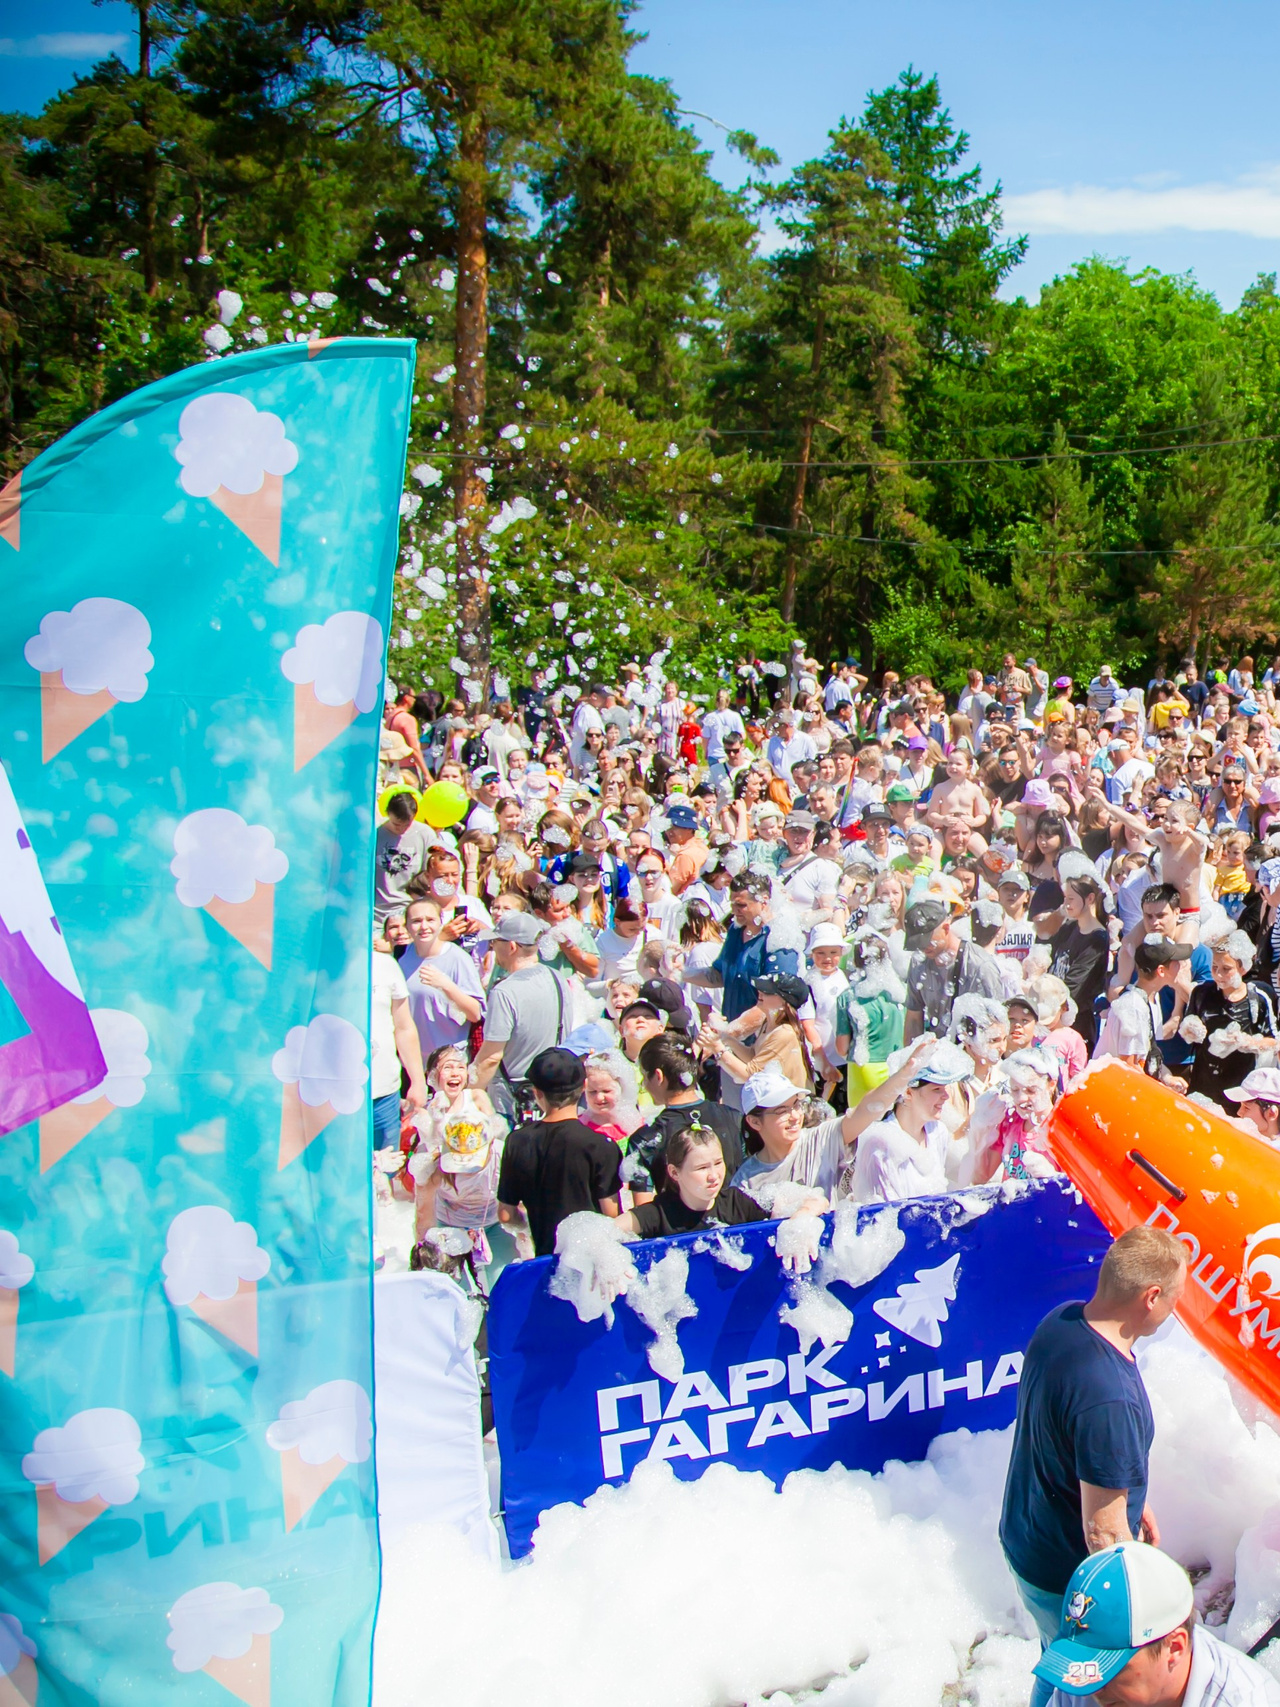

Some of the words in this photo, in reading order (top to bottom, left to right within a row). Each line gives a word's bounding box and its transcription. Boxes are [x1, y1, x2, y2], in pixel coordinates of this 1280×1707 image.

[995, 933, 1033, 946] ЗАЛИЯ
[596, 1344, 847, 1433] ПАРК
[600, 1350, 1027, 1479] ГАГАРИНА
[1069, 1662, 1098, 1679] 20
